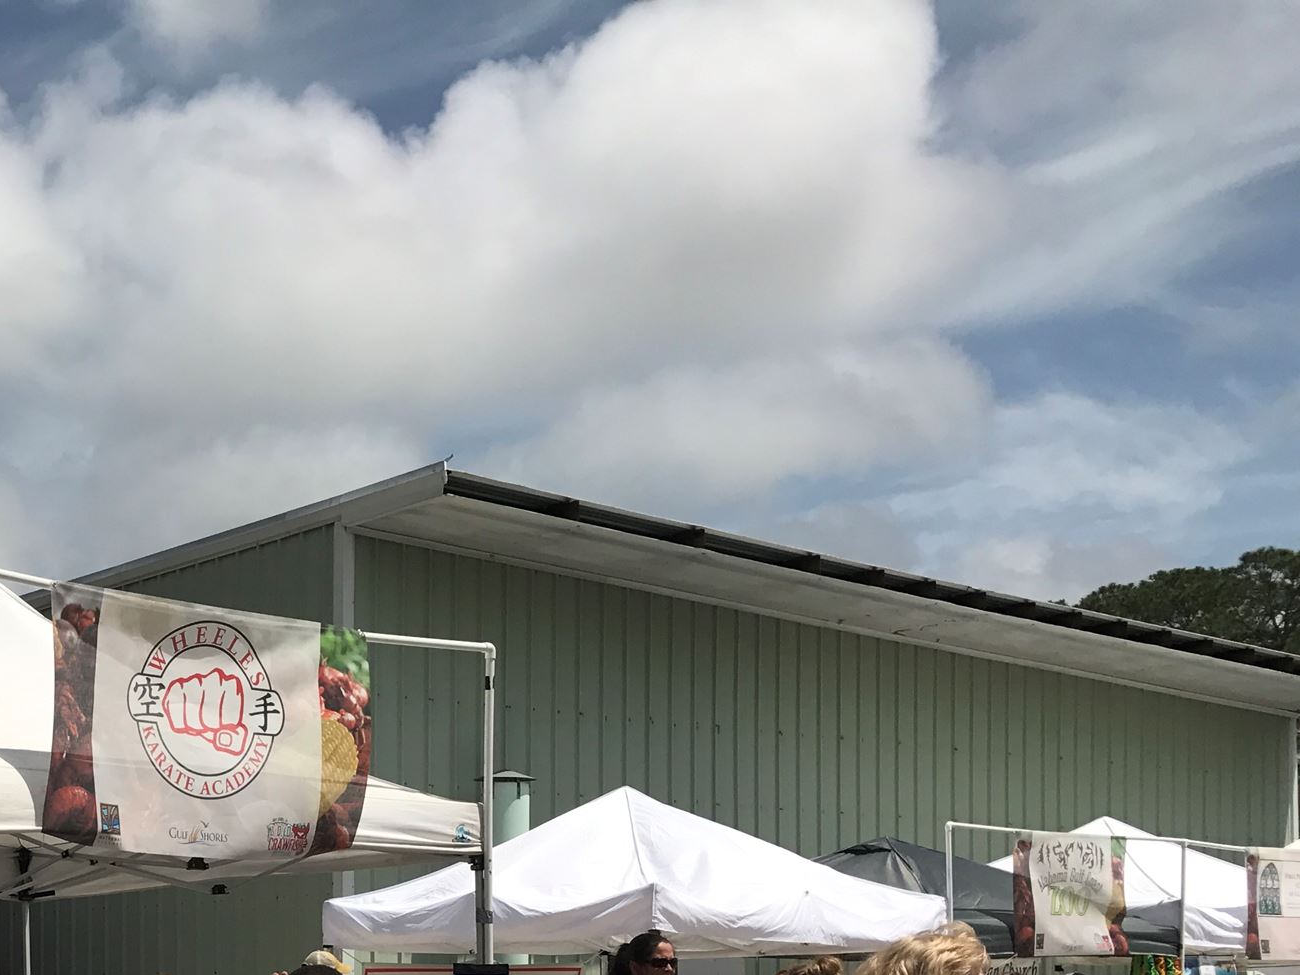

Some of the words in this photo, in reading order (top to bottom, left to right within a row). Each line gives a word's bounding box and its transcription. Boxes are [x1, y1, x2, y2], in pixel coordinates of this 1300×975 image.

[148, 626, 265, 687] WHEELES
[133, 677, 165, 718] 空
[249, 692, 280, 733] 手
[143, 726, 196, 792] KARATE
[200, 736, 268, 796] ACADEMY
[1050, 885, 1091, 917] ZOO
